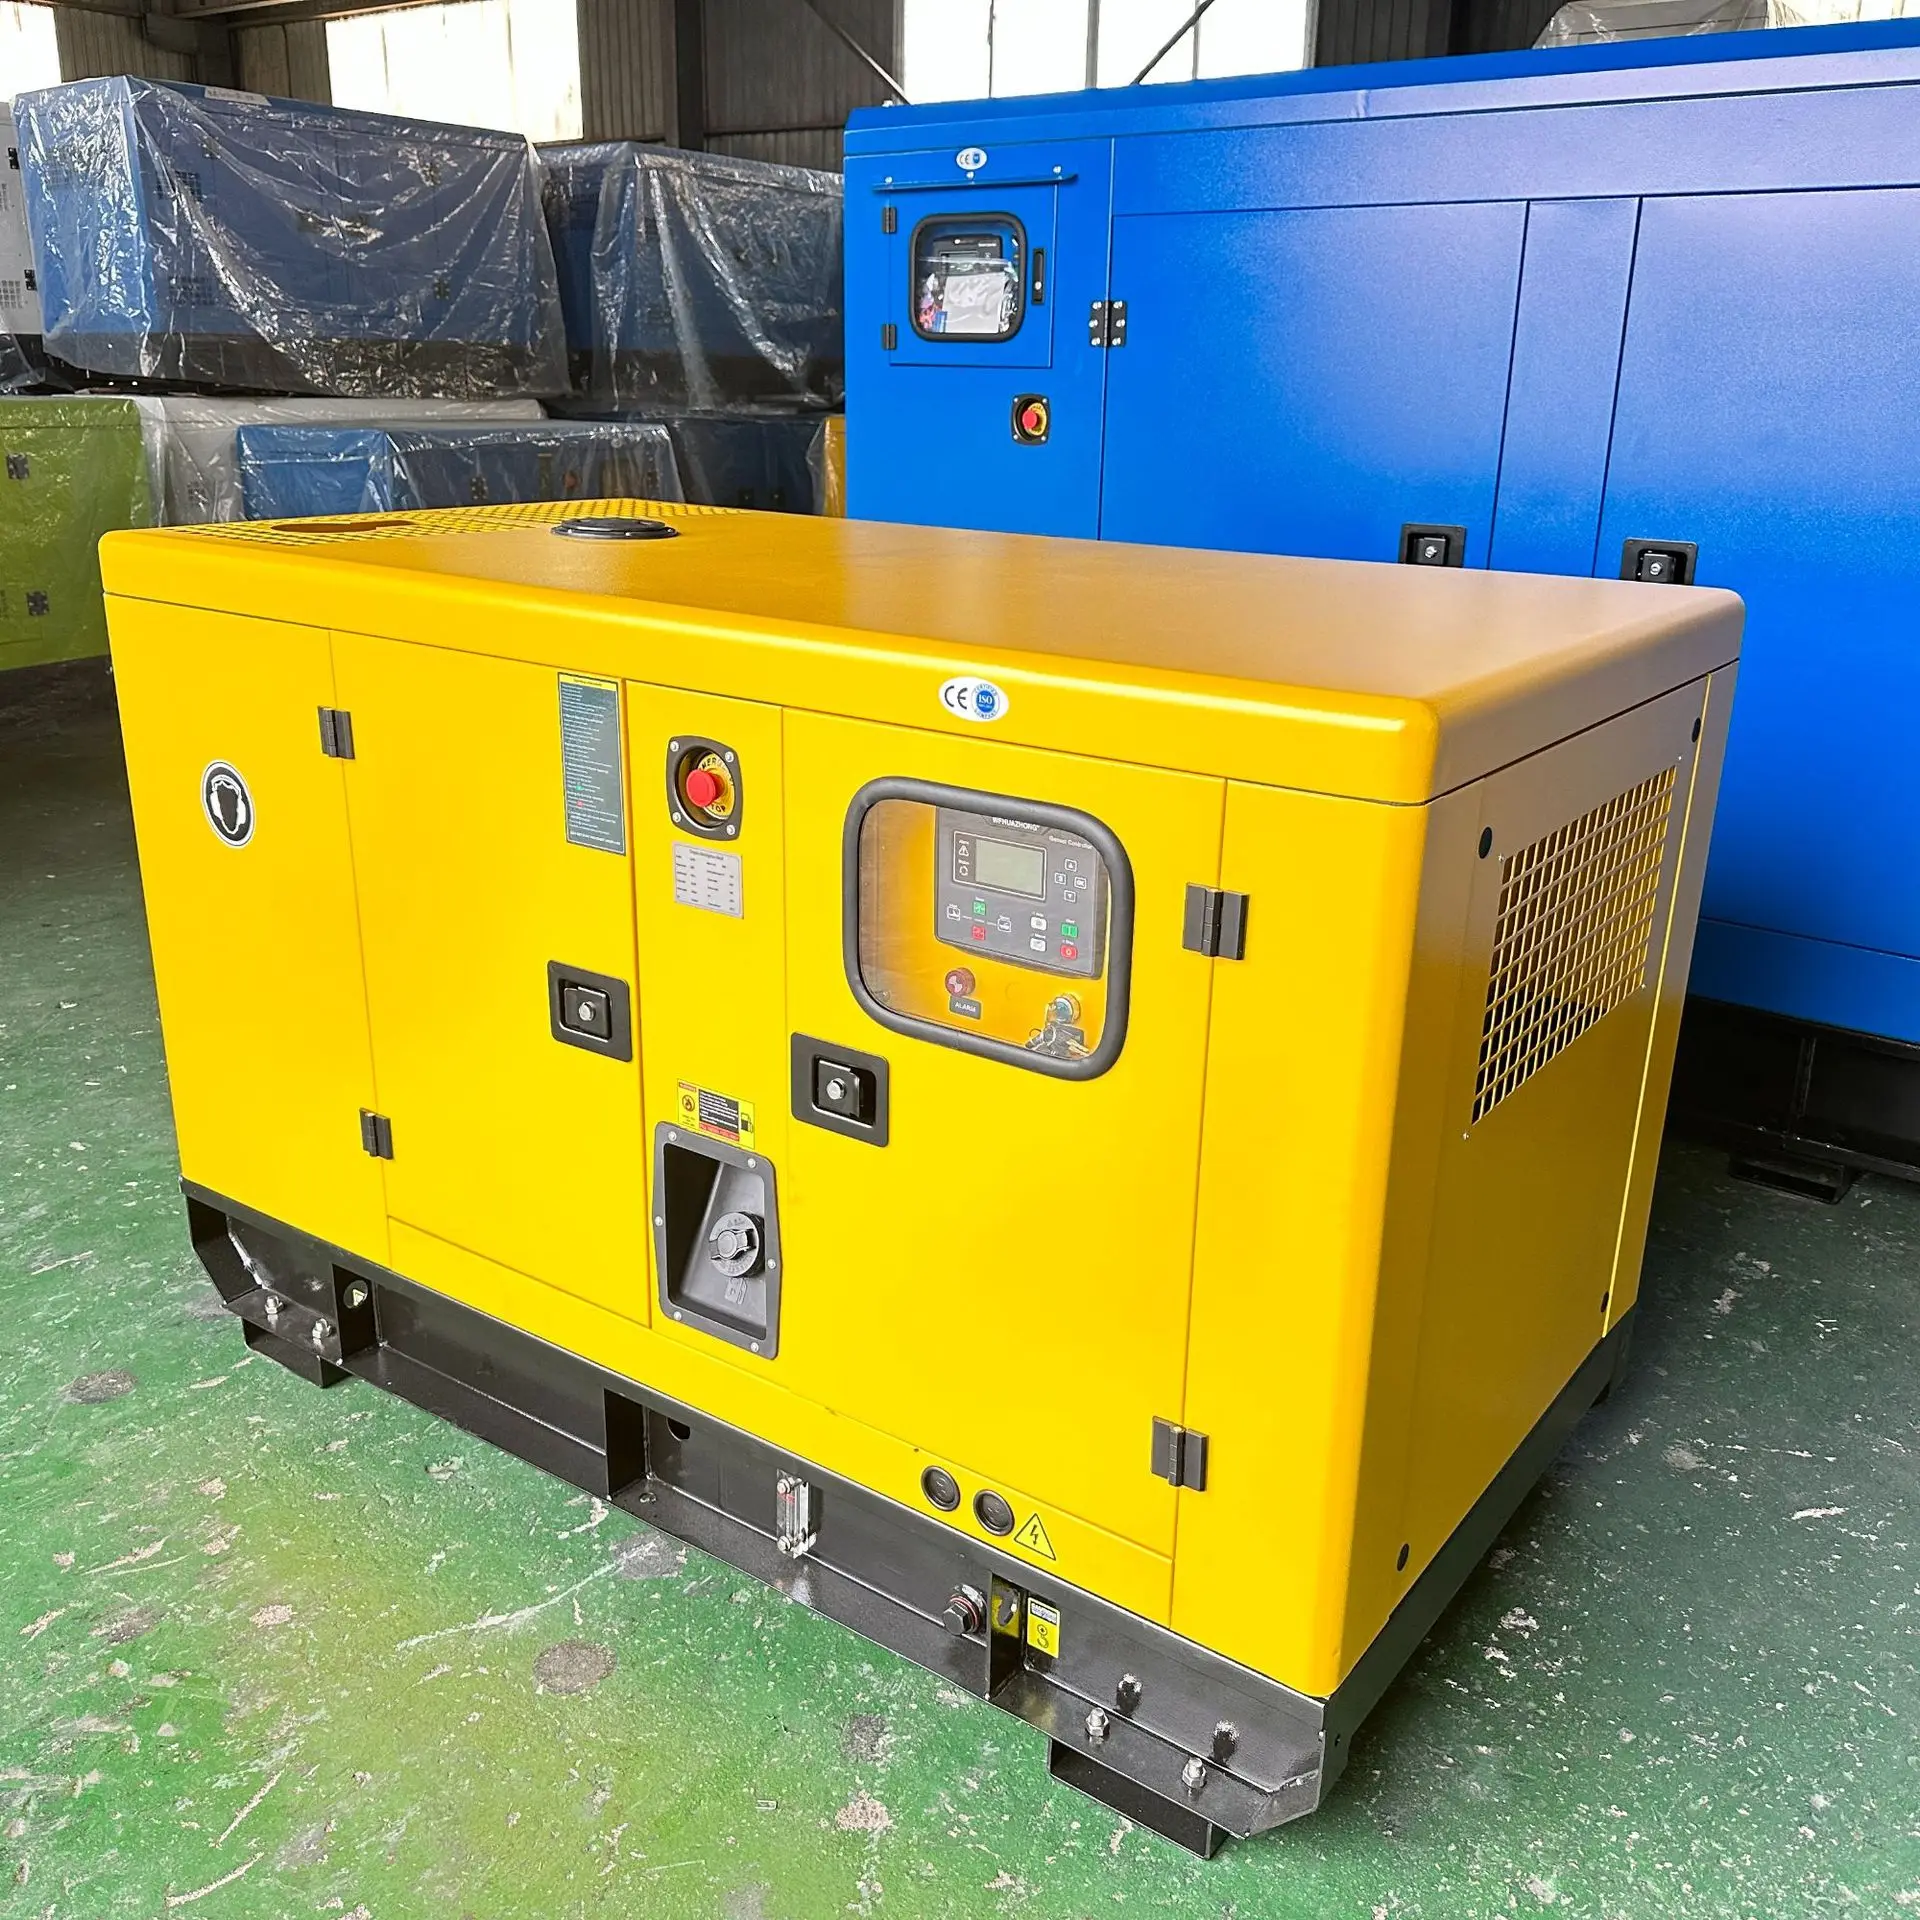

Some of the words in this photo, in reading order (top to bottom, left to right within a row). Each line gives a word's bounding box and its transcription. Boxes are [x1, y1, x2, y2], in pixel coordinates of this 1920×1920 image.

[944, 685, 968, 710] CE
[978, 694, 993, 704] ISO
[955, 1001, 976, 1012] ALARM
